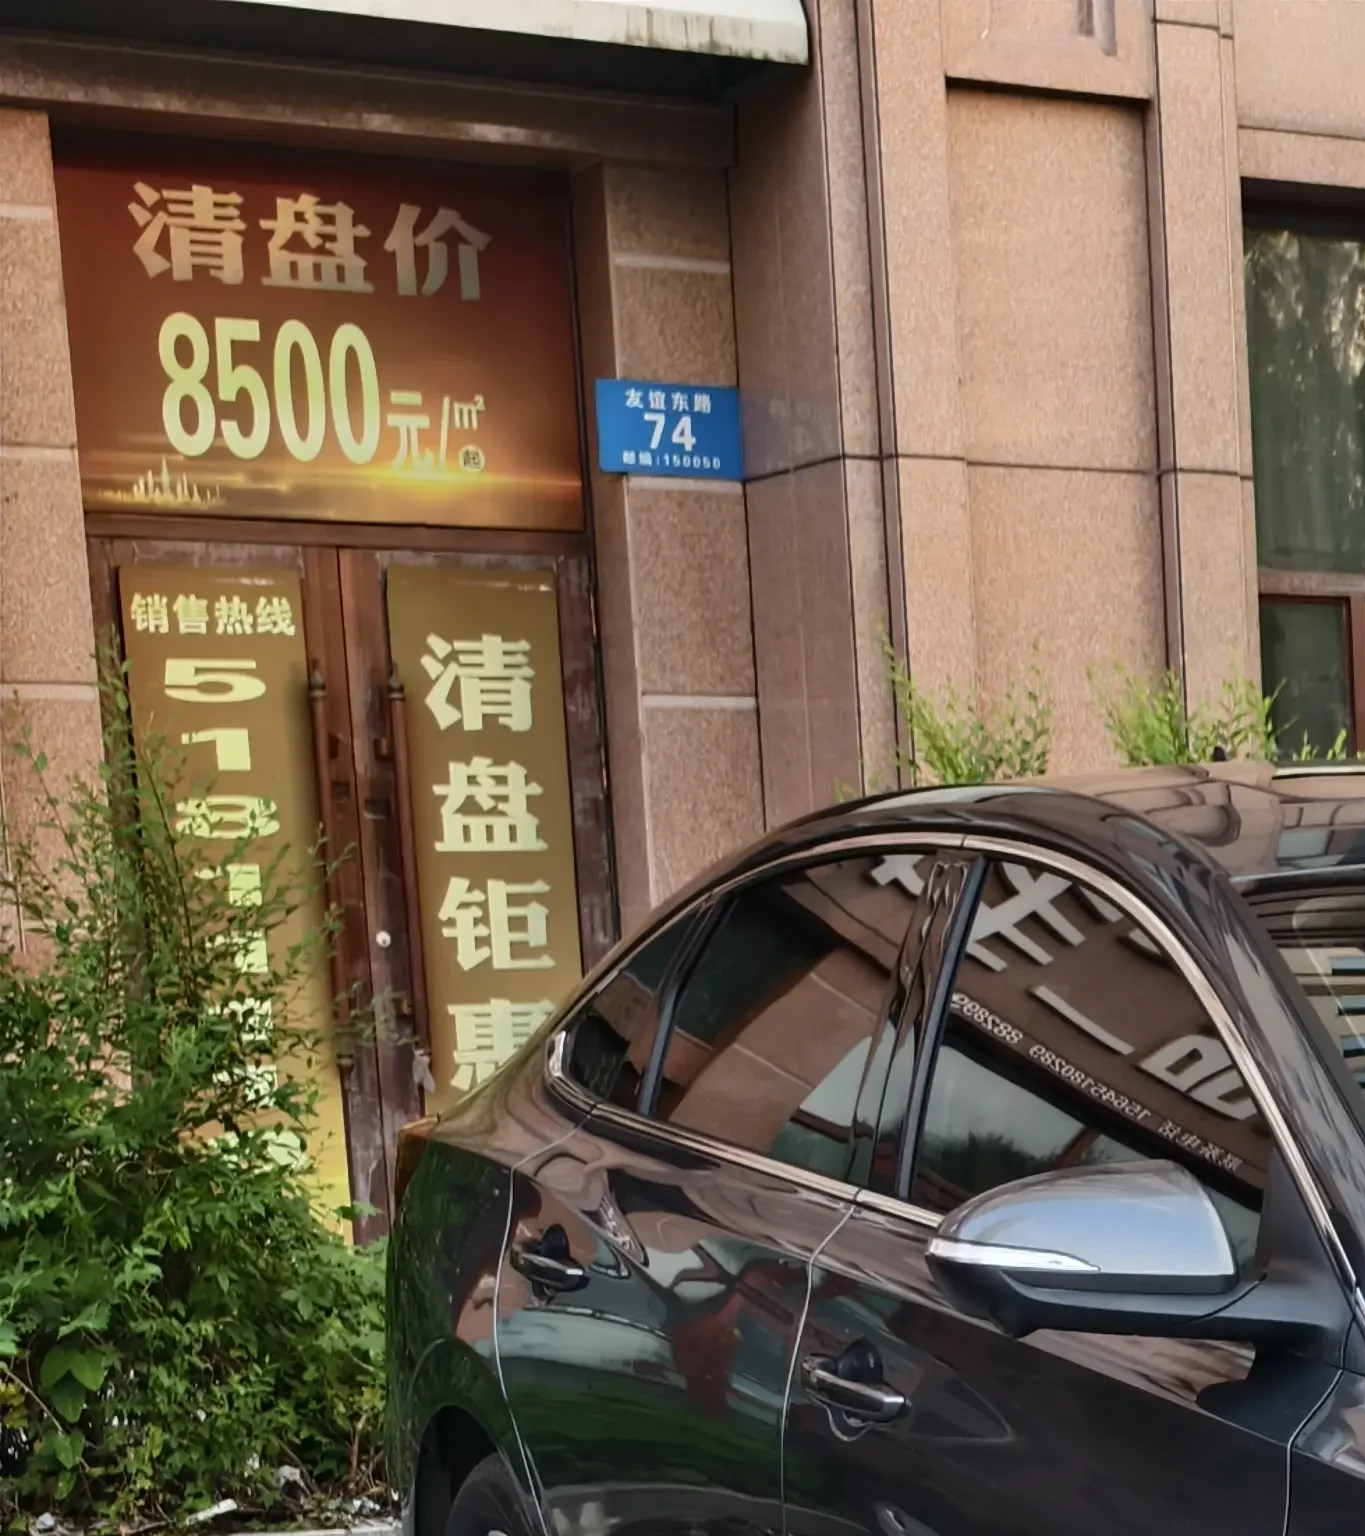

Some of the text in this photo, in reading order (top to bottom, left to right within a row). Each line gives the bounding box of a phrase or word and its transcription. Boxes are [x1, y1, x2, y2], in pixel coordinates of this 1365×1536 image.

[127, 180, 492, 301] 清盘价
[625, 387, 712, 413] 友谊东路
[643, 412, 696, 451] 74
[130, 592, 296, 636] 销售热线
[420, 633, 556, 1092] 清盘钜惠
